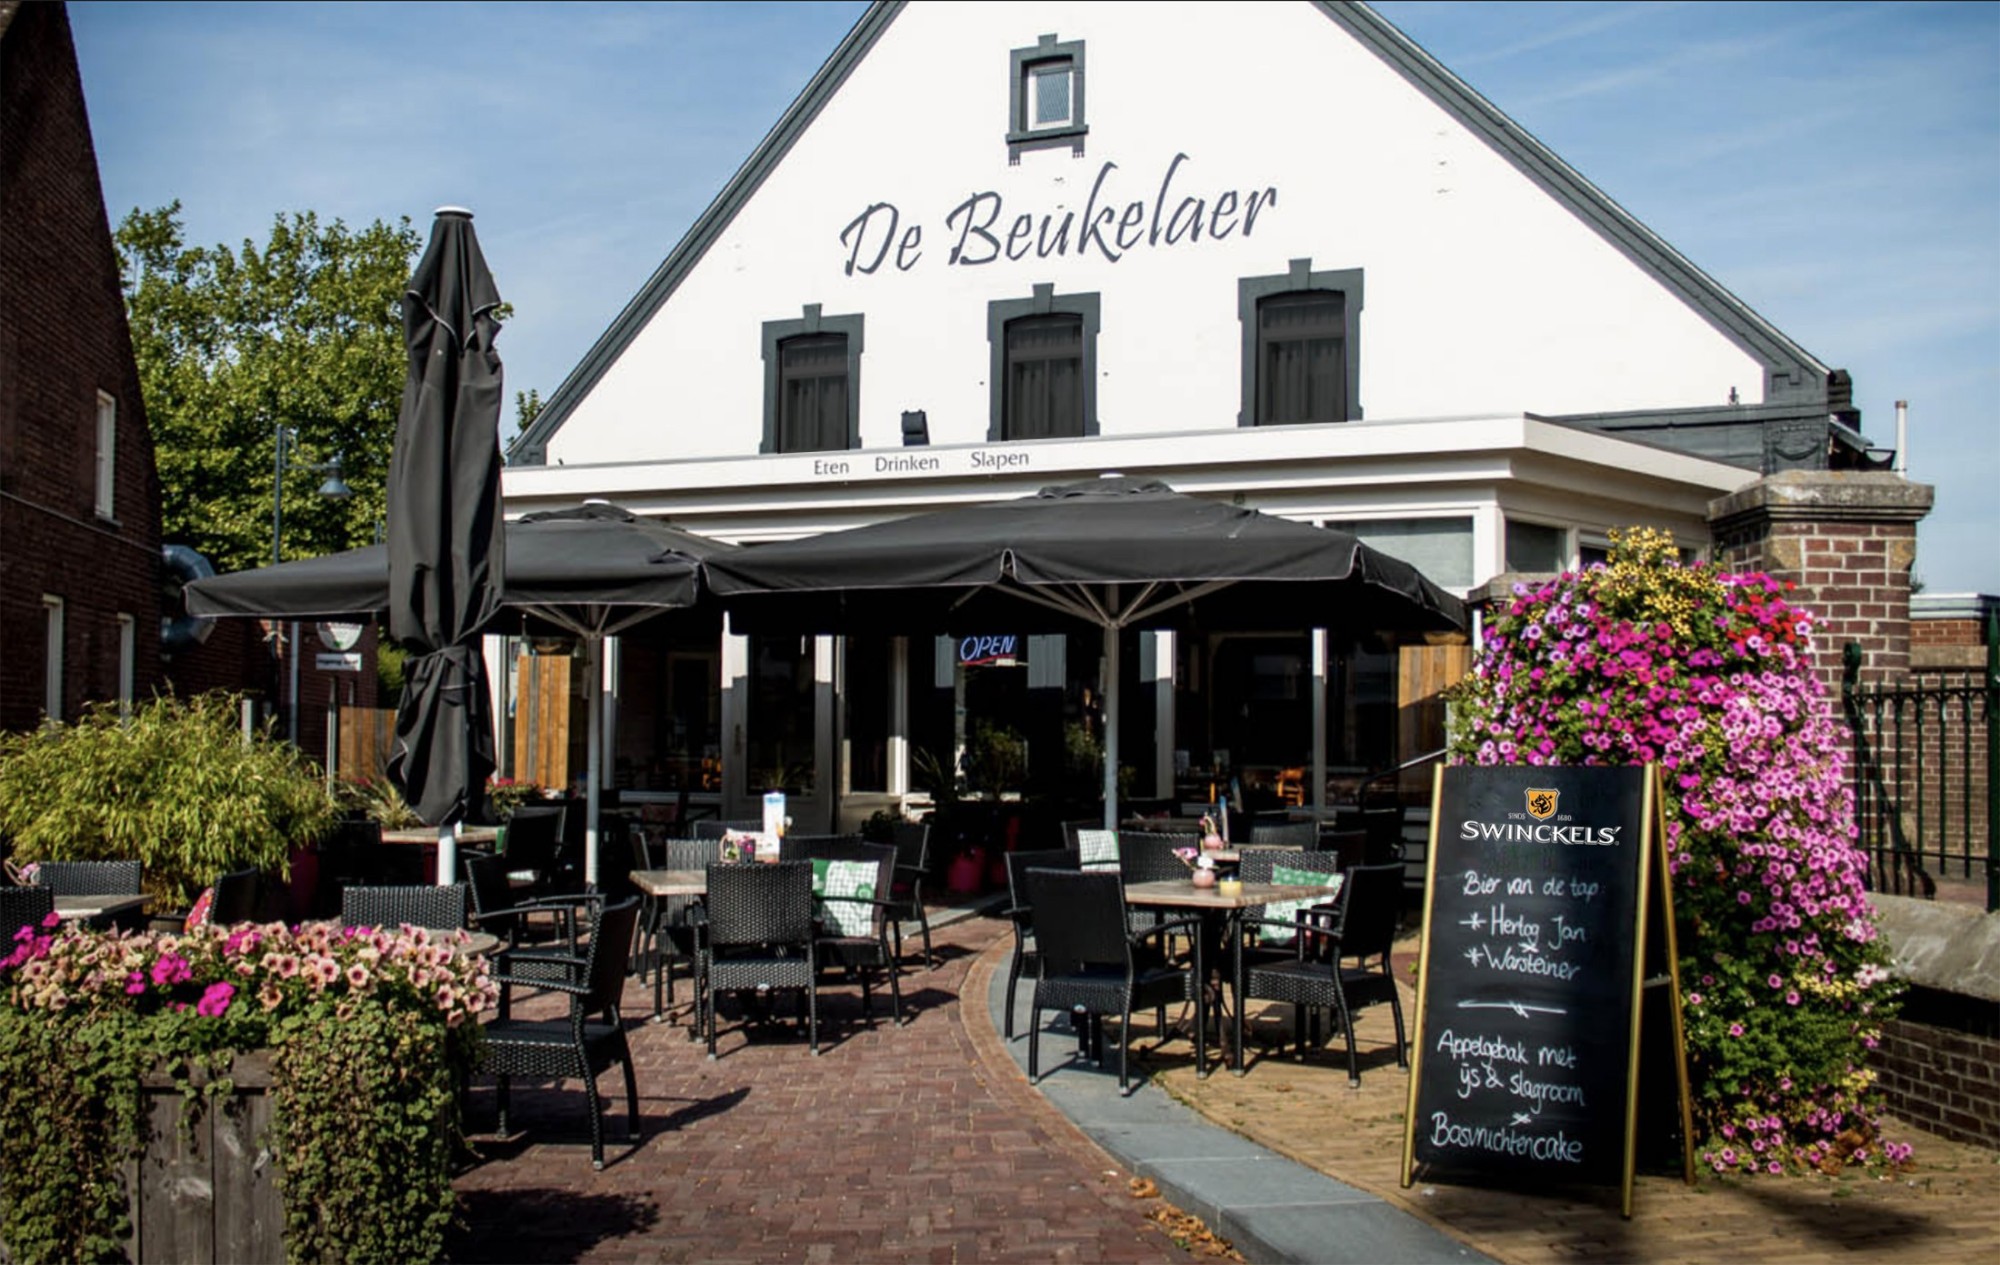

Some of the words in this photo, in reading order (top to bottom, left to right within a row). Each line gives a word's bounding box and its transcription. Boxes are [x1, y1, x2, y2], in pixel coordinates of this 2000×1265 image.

[841, 202, 922, 276] De
[945, 152, 1277, 264] Beukelaer
[814, 460, 849, 475] Eten
[875, 456, 940, 473] Drinken
[970, 451, 1030, 470] Slapen
[960, 636, 1016, 661] OPEN
[1463, 870, 1501, 895] Bier
[1507, 877, 1533, 895] van
[1542, 877, 1565, 896] de
[1491, 903, 1540, 944] Hertog
[1548, 915, 1586, 950] Jan
[1482, 943, 1581, 981] Warsteiner
[1437, 1029, 1529, 1068] Appelgebak
[1538, 1046, 1577, 1069] met
[1485, 1066, 1504, 1088] &
[1509, 1069, 1586, 1114] slagroom
